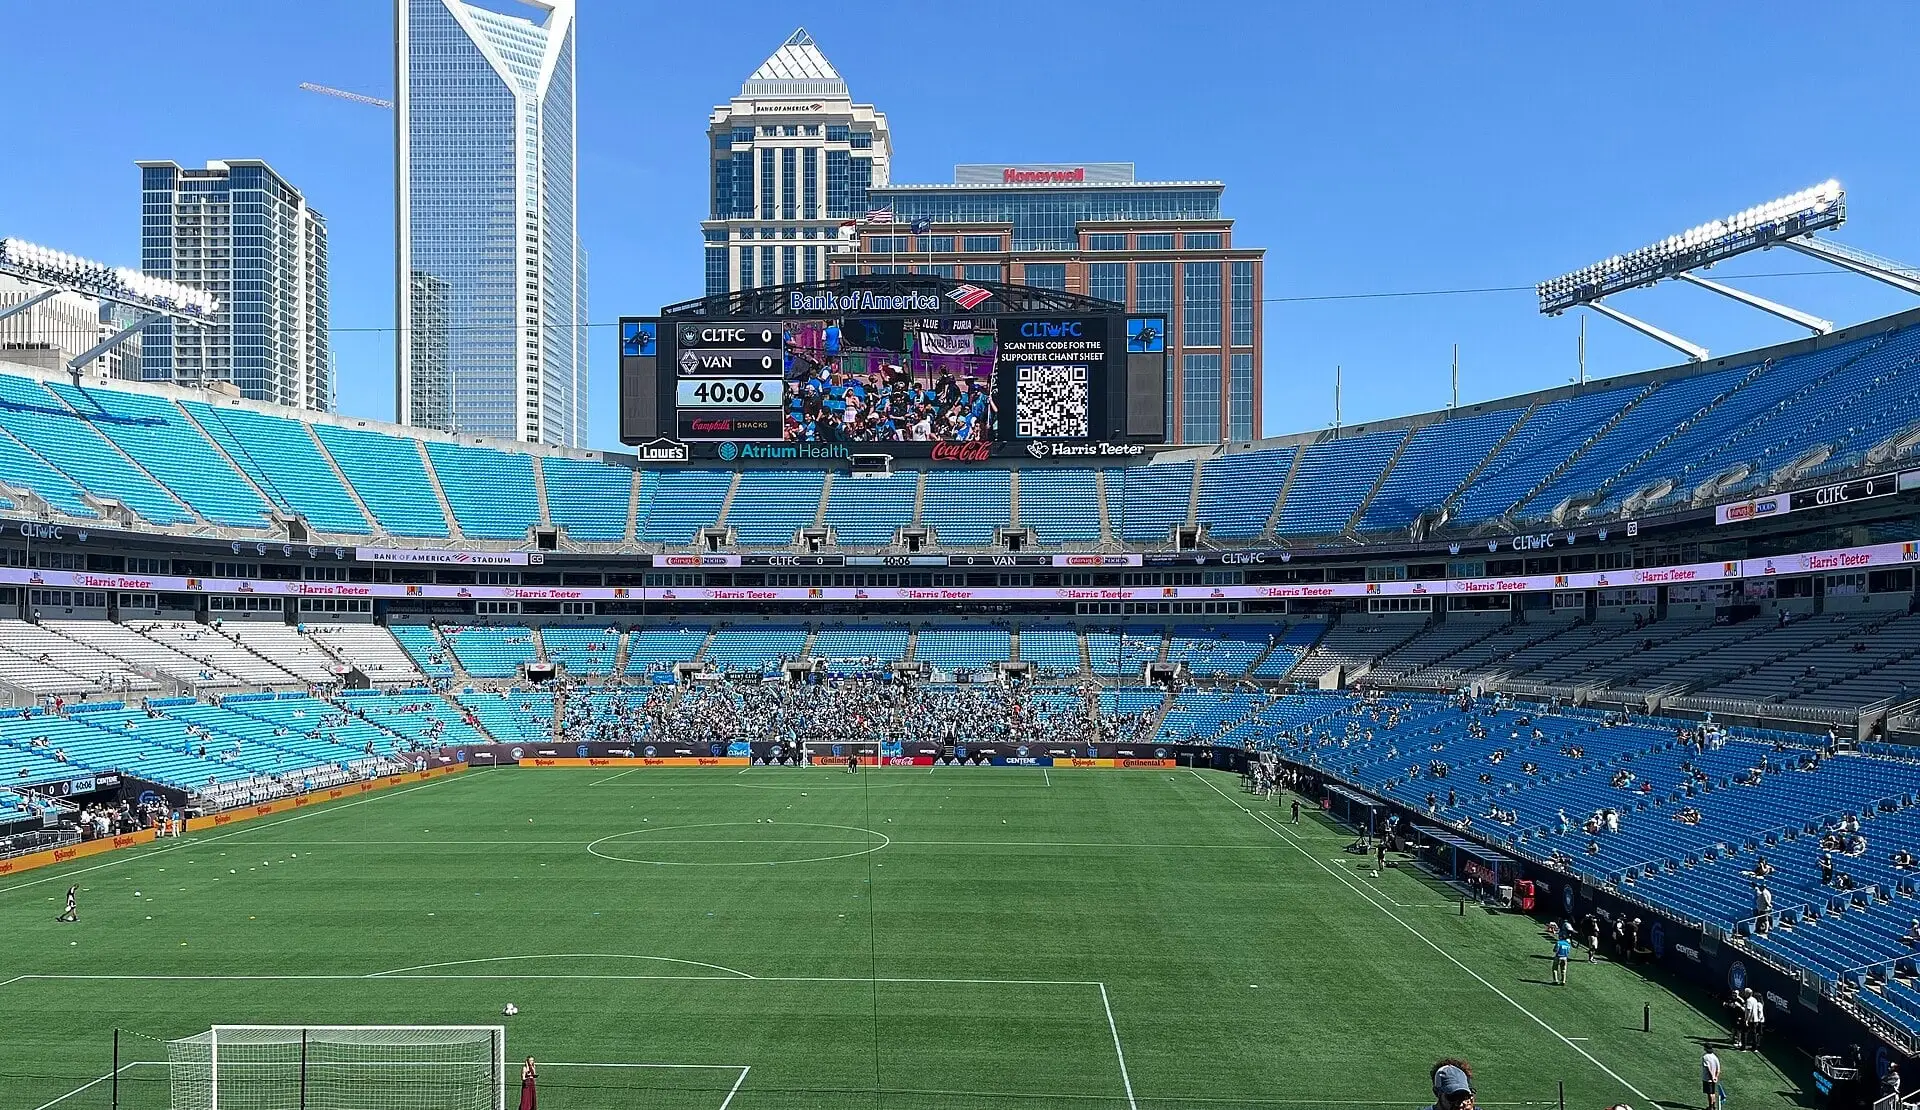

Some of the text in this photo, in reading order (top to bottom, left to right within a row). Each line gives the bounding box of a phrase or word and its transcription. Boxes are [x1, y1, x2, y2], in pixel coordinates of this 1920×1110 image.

[1003, 168, 1085, 184] Honeywell
[790, 291, 940, 310] Bank of America
[702, 327, 772, 343] CLTFC 0
[1004, 342, 1026, 350] SCAN
[1027, 342, 1044, 350] THIS
[1045, 342, 1068, 350] CODE
[1085, 341, 1101, 349] THE
[702, 355, 773, 369] VAN 0
[1001, 352, 1104, 362] SUPPORTER CHANT SHEET
[694, 382, 765, 403] 40:06
[643, 446, 684, 459] LOWE'S
[741, 443, 848, 458] Atrium Health
[1052, 442, 1145, 456] Harris Teeter
[1816, 481, 1874, 505] CLTFC 0
[411, 554, 451, 563] AMERICA
[472, 556, 511, 564] STADIUM
[768, 557, 824, 565] CLTFC 0
[882, 556, 910, 565] 40:06
[967, 556, 1016, 565] 0 VAN
[1809, 553, 1871, 569] Harris Teeter
[1641, 569, 1696, 582] Harris Teeter
[85, 576, 151, 588] Harris Teeter
[1465, 580, 1527, 591] Harris Teeter
[298, 584, 369, 595] Harris Teeter
[515, 589, 581, 598] Harris Teeter
[714, 590, 777, 599] Harris Teeter
[908, 590, 973, 599] Harris Teeter
[1068, 590, 1132, 598] Harris Teeter
[1268, 587, 1333, 597] Harris Teeter
[1006, 757, 1036, 765] CENTENE
[1123, 759, 1161, 767] Continental
